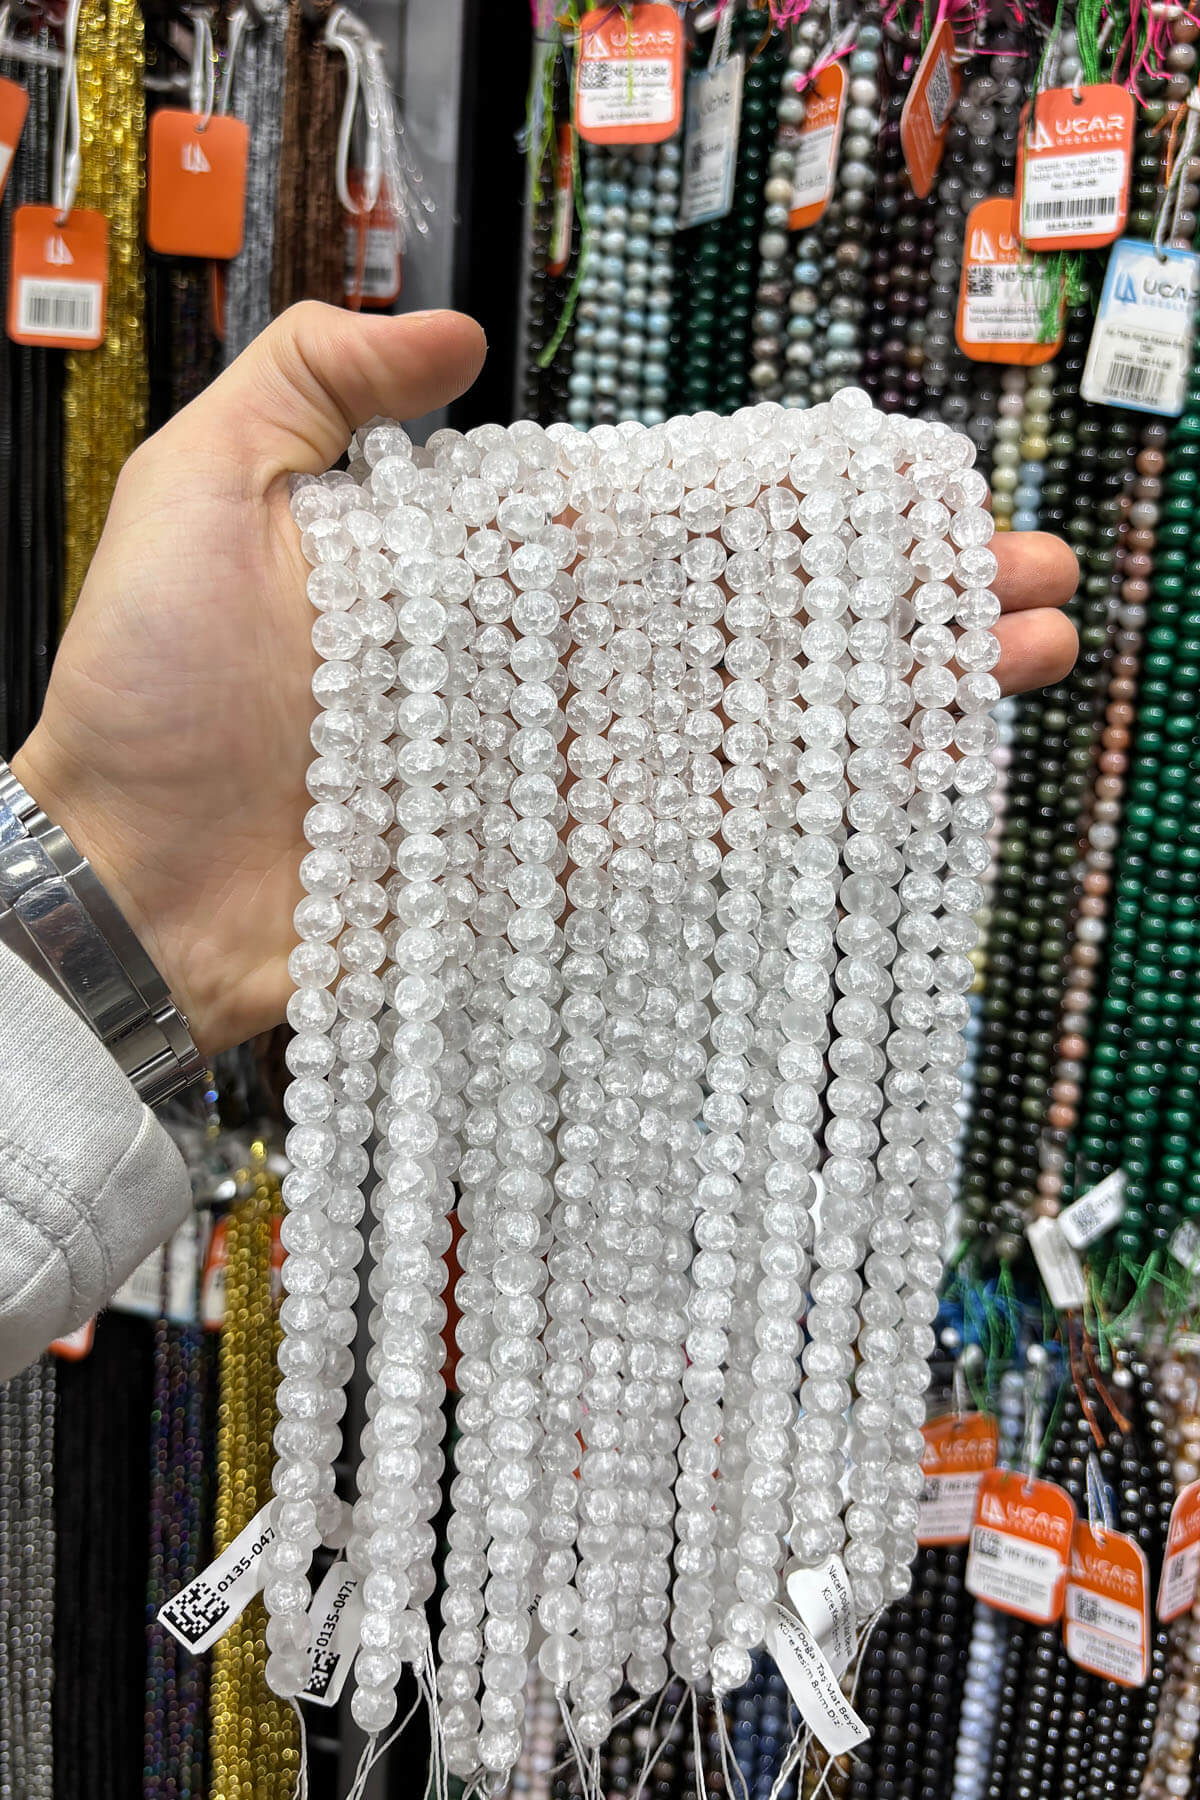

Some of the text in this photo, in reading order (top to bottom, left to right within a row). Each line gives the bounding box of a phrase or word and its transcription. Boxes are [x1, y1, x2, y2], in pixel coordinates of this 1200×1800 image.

[610, 31, 675, 48] UCAR
[1055, 113, 1126, 136] UCAR
[1006, 1501, 1067, 1534] UCAR
[1085, 1554, 1137, 1584] UCAR
[316, 1580, 358, 1647] 0135-0471
[779, 1622, 796, 1646] Küre
[793, 1646, 813, 1680] Kesim
[811, 1680, 829, 1710] 8mm
[816, 1662, 828, 1683] Taş
[826, 1683, 841, 1707] Mat
[839, 1706, 862, 1735] Beyaz
